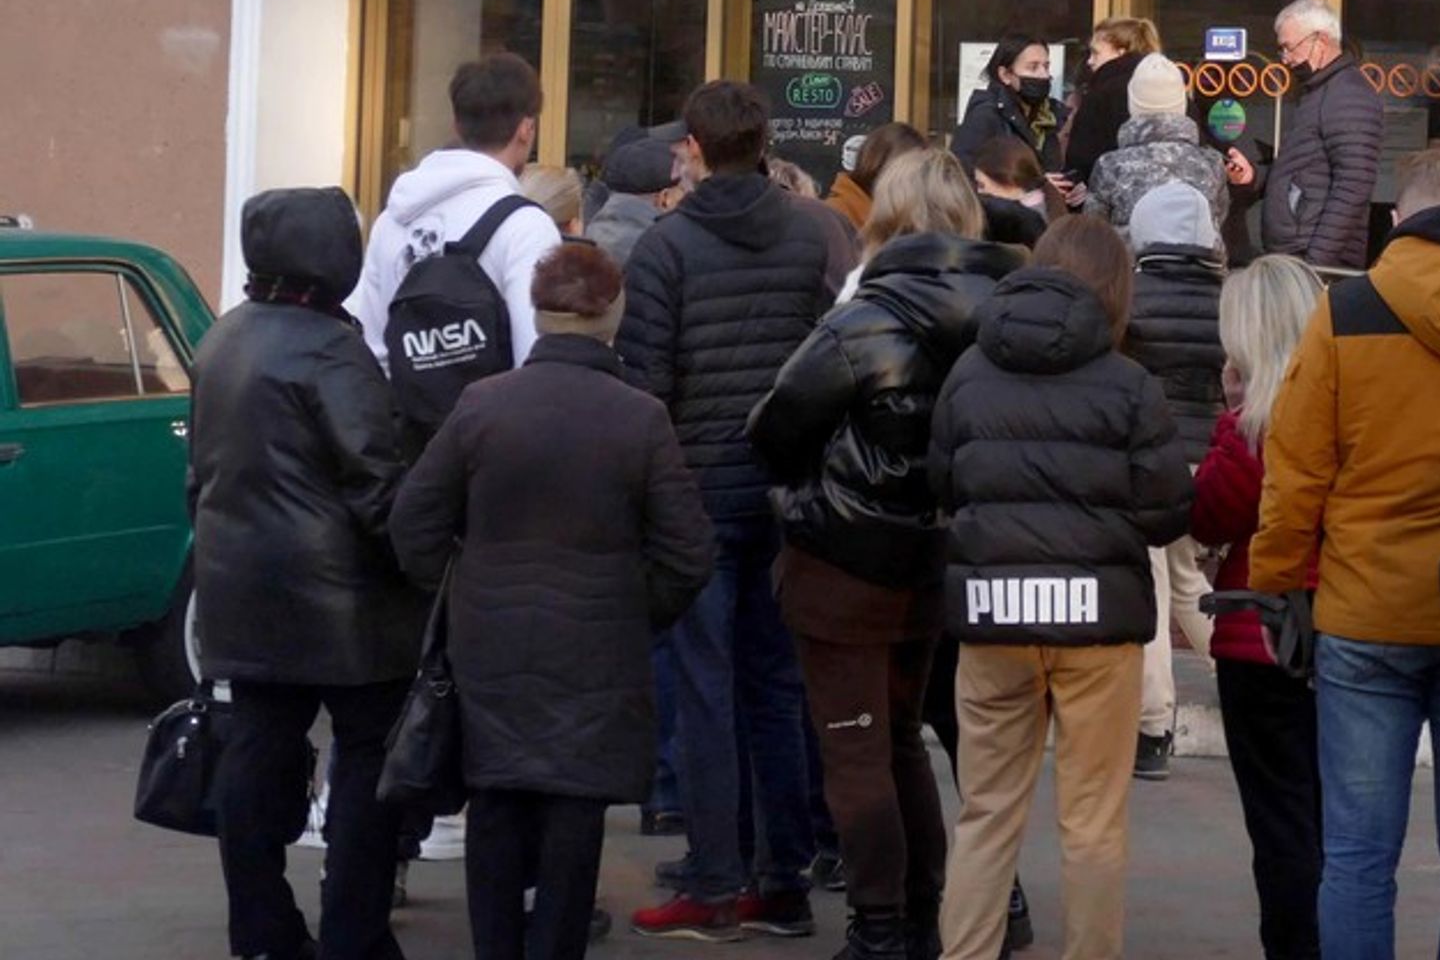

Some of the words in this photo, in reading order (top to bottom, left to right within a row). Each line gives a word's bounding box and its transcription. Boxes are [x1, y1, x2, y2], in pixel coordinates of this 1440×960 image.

[763, 10, 873, 56] МАЙСТЕР-КЛАС
[792, 88, 834, 103] RESTO
[403, 319, 487, 357] NASA
[966, 577, 1098, 624] PUMA
